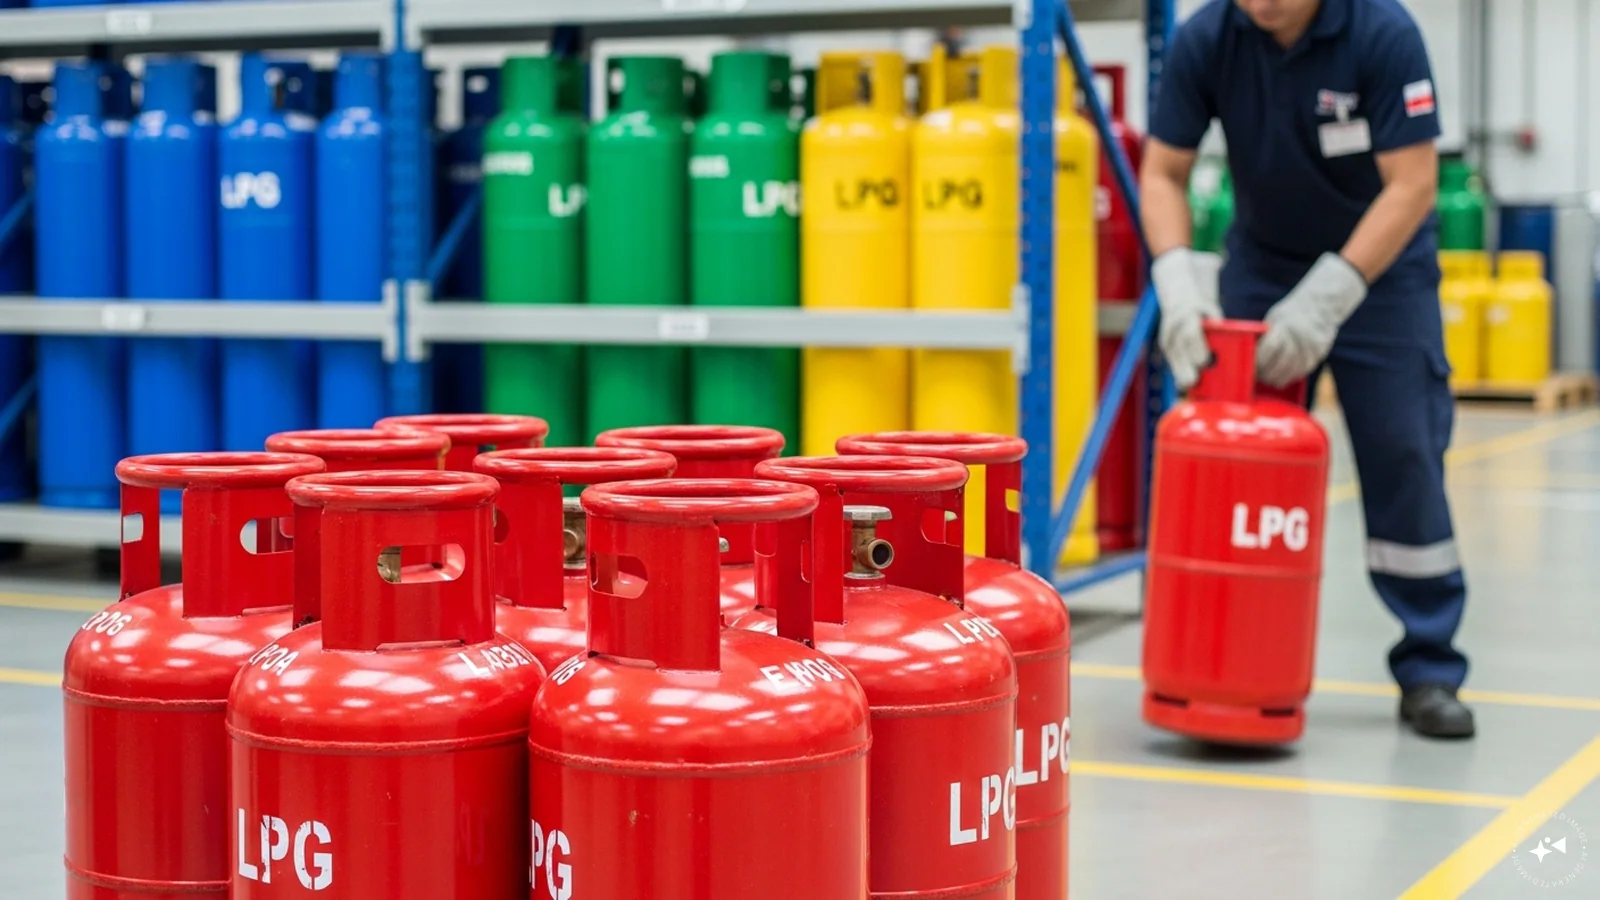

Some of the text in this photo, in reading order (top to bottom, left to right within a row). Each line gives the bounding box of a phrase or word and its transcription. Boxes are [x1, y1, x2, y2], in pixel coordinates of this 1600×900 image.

[221, 171, 281, 208] LPG
[834, 178, 899, 211] LPG
[921, 179, 984, 210] LPG
[1231, 502, 1309, 551] LPG
[1016, 717, 1069, 785] LPG
[950, 766, 1015, 845] LPG
[238, 808, 332, 890] LPG
[529, 819, 572, 900] PG
